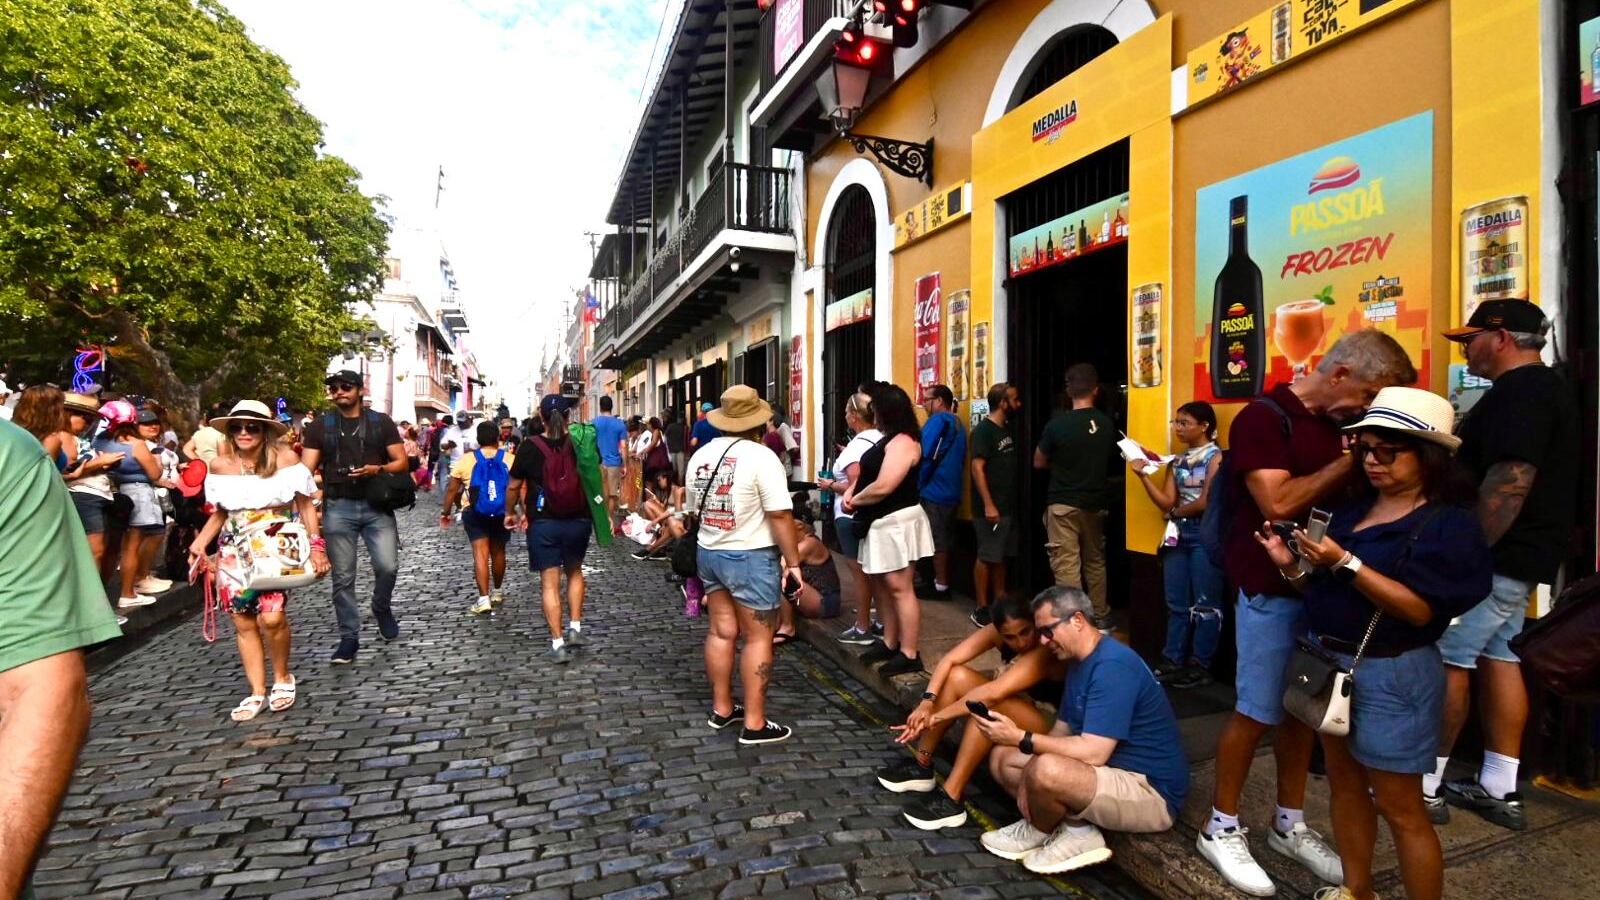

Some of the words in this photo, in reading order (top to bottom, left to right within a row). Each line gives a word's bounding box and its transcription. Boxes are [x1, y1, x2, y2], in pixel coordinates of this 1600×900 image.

[1032, 100, 1078, 136] MEDALLA
[1465, 208, 1522, 231] MEDALLA
[1280, 231, 1395, 280] FROZEN
[1088, 419, 1098, 434] J
